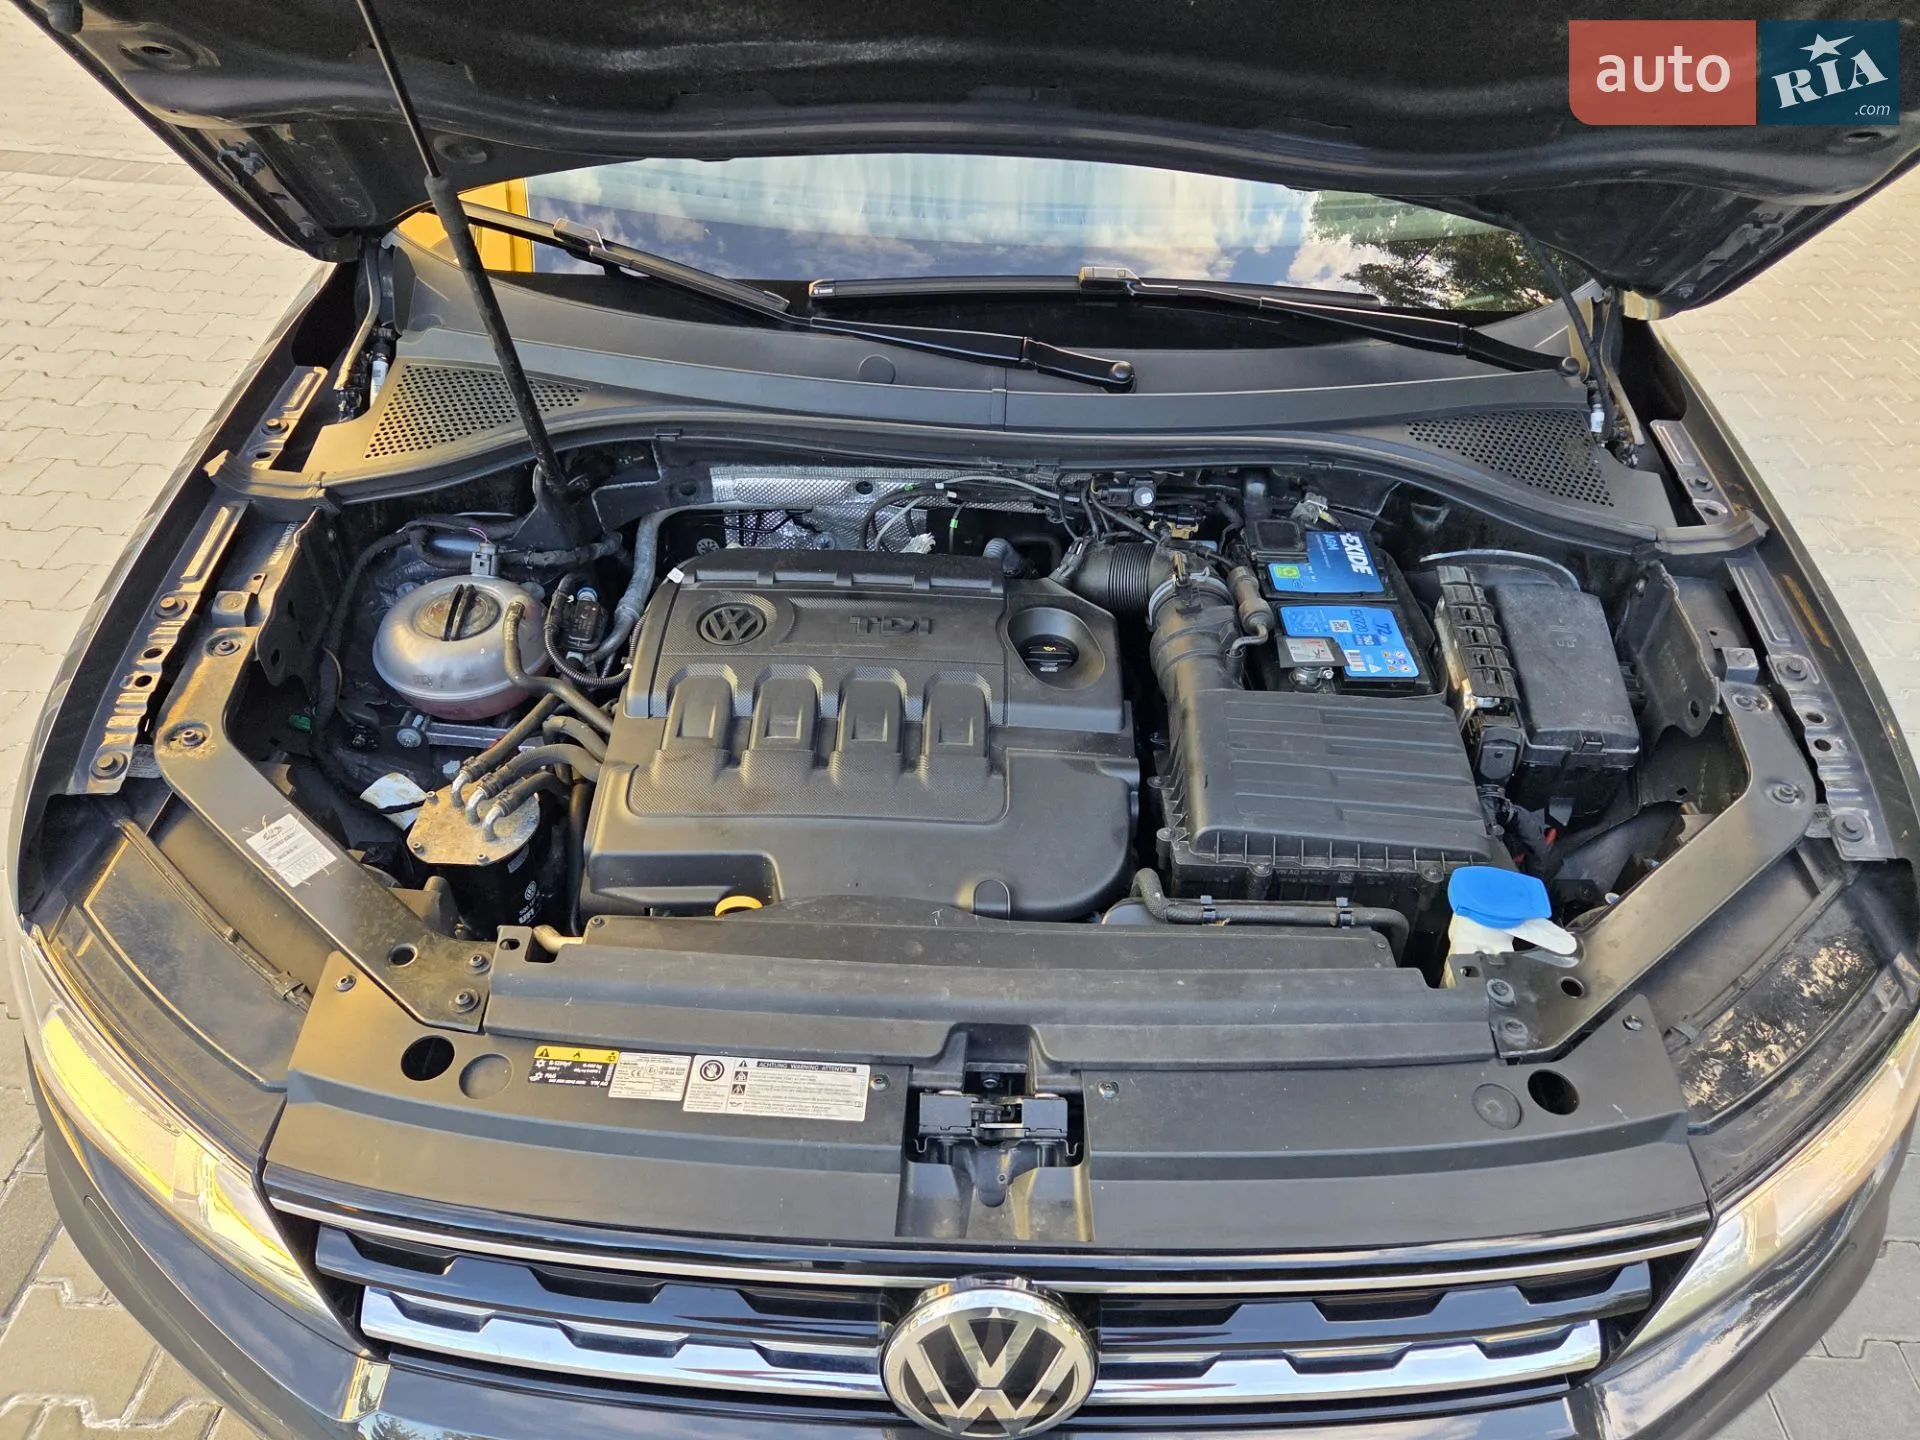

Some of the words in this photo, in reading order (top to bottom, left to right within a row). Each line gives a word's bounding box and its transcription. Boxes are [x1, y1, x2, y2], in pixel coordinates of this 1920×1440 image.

[1322, 533, 1340, 551] AGM
[1339, 533, 1374, 577] EXIDE
[849, 615, 935, 636] TDI
[1350, 609, 1369, 633] EK720
[1375, 623, 1391, 635] 72
[821, 1065, 853, 1073] ATTENTION
